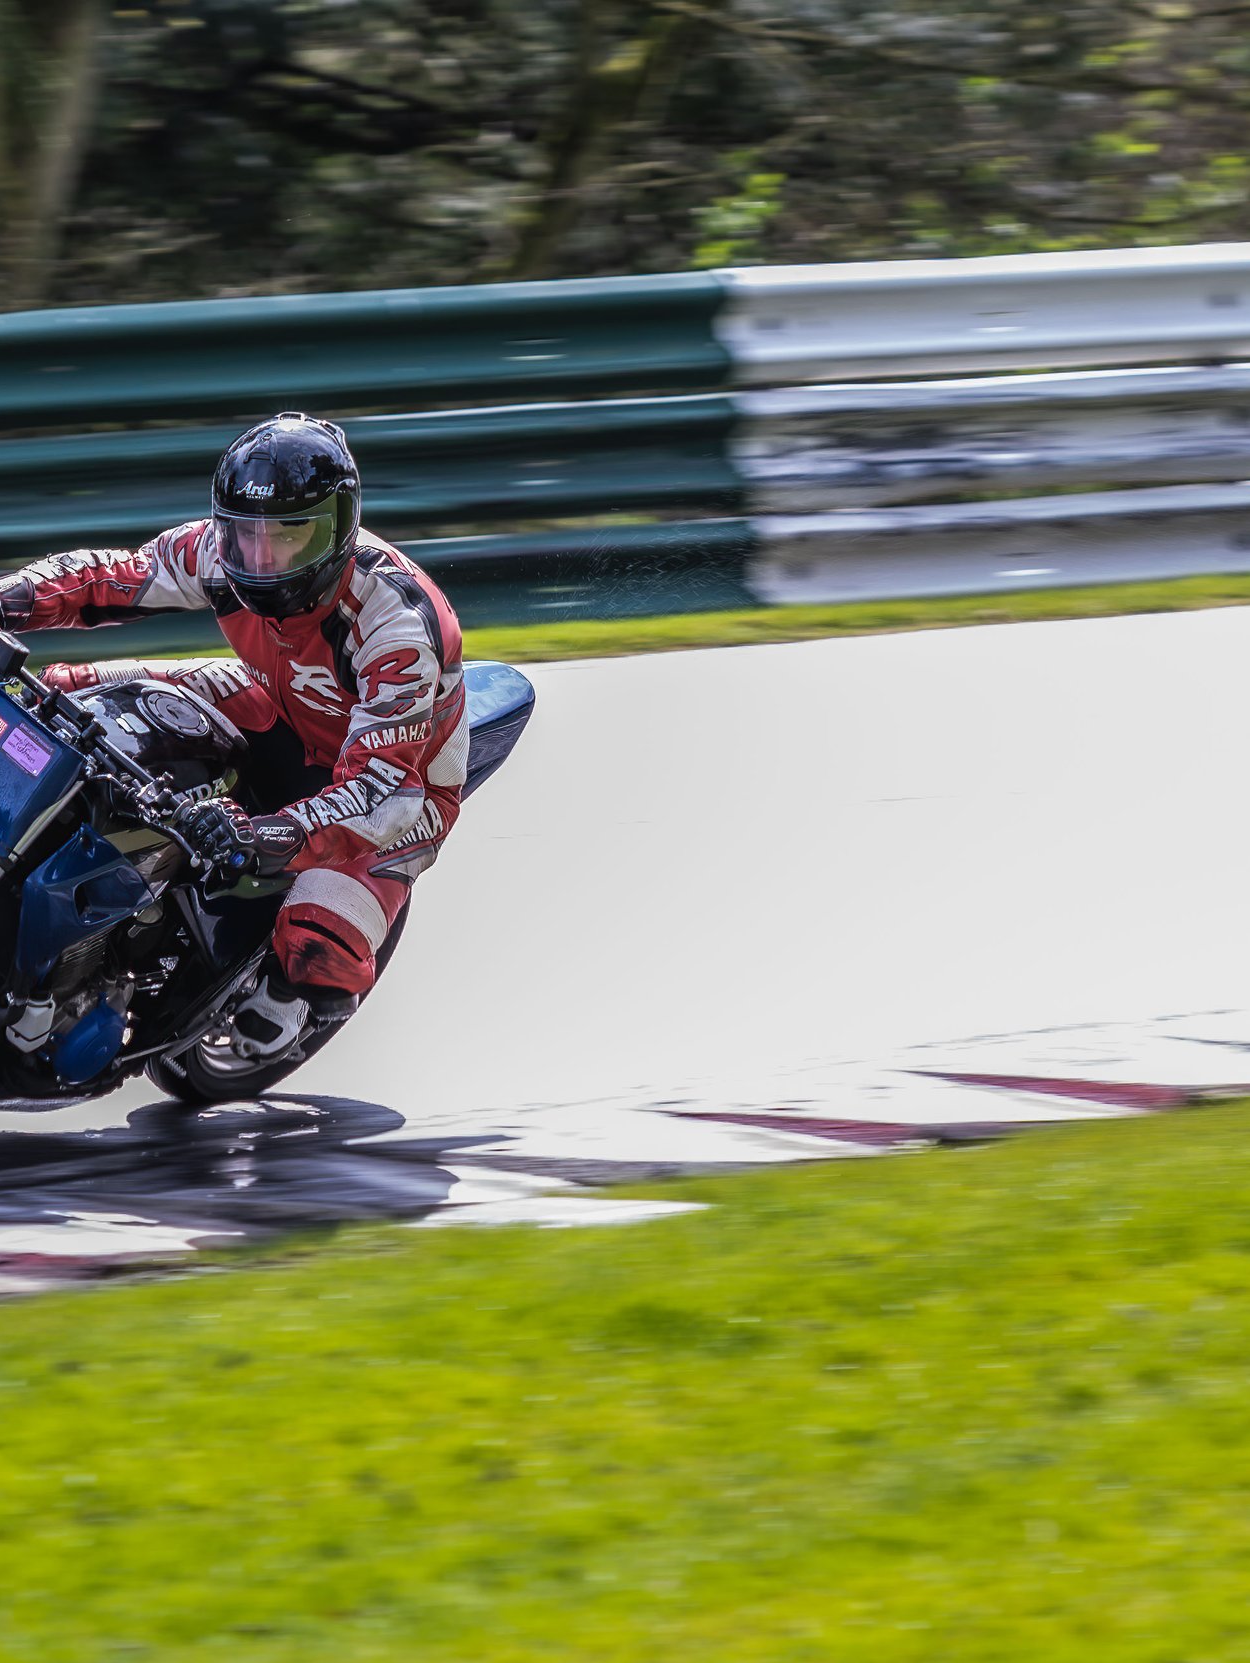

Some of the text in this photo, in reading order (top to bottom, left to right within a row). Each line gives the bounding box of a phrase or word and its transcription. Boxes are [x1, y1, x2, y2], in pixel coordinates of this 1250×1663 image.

[236, 480, 275, 497] Arai
[359, 721, 427, 750] YAMAHA
[172, 777, 229, 804] NDA
[285, 756, 407, 833] YAMAHA
